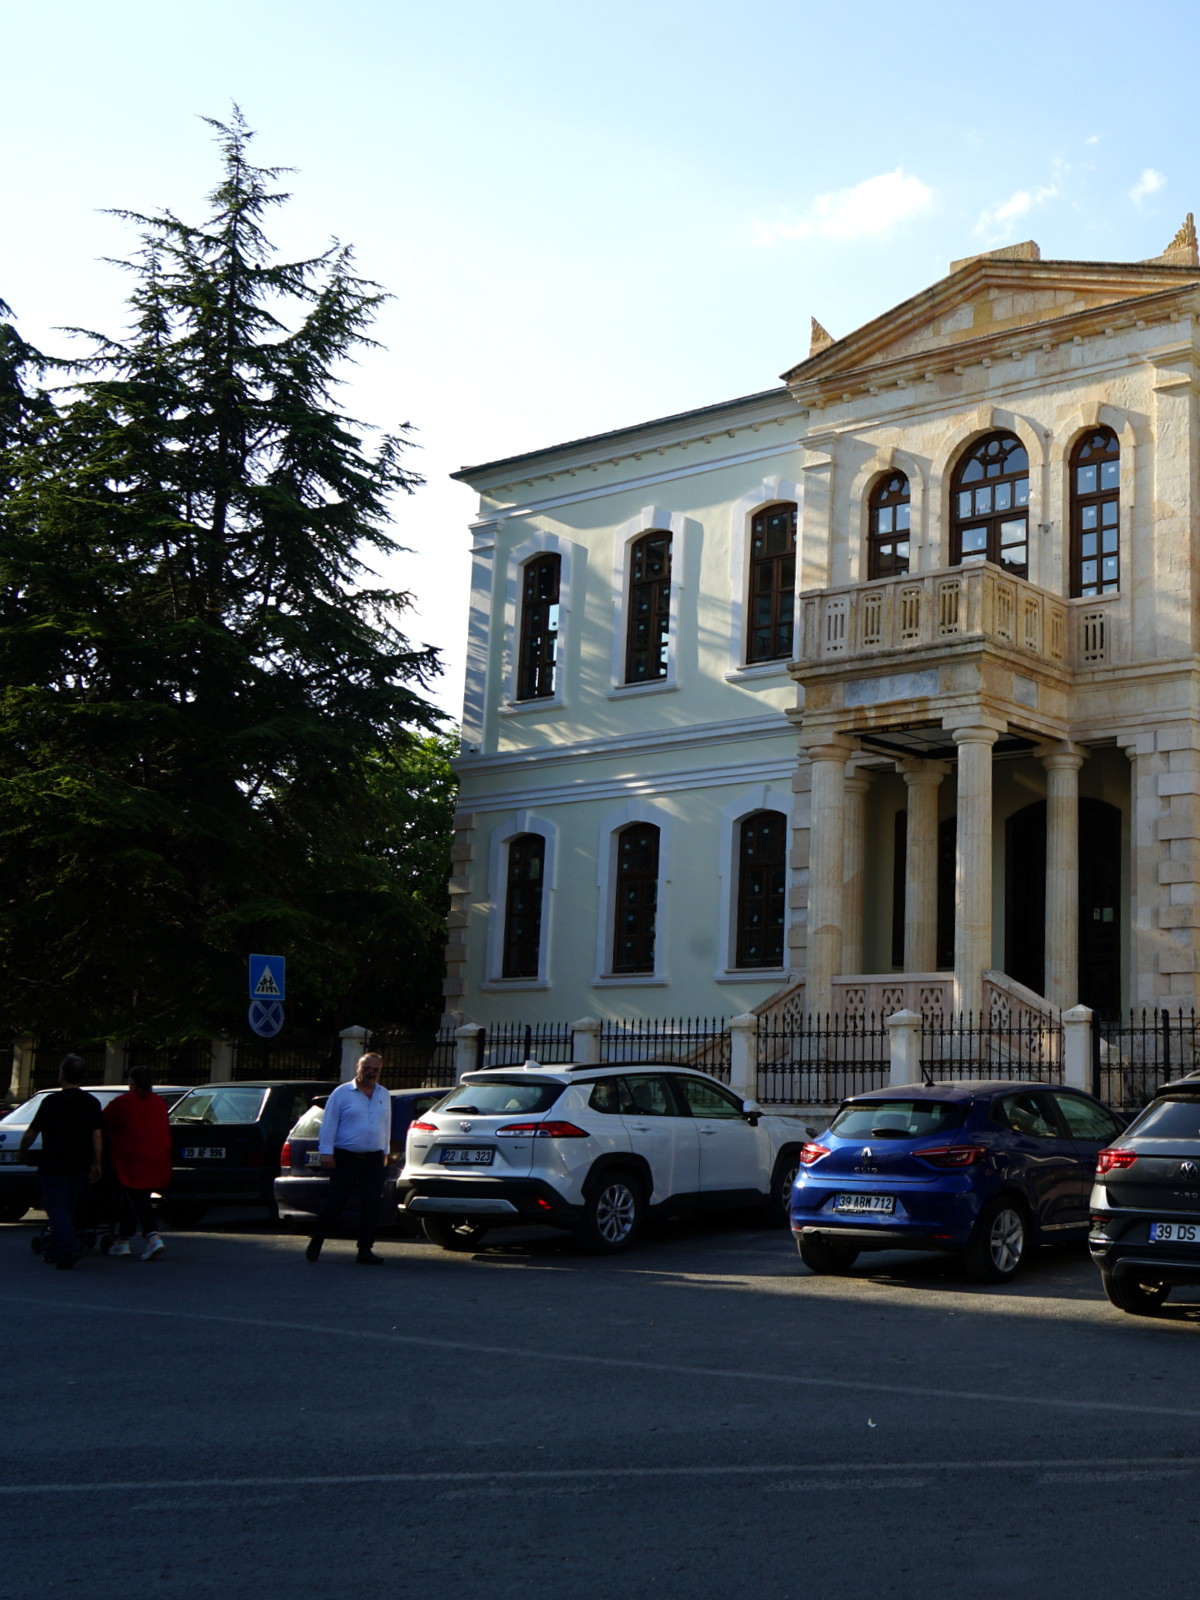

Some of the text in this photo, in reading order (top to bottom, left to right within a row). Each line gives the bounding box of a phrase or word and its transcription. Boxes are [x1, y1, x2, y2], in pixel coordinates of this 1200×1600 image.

[445, 1151, 491, 1161] 22 UL 323
[839, 1195, 851, 1207] 39
[874, 1197, 892, 1209] 712
[1156, 1224, 1172, 1239] 39
[1177, 1226, 1196, 1240] DS
